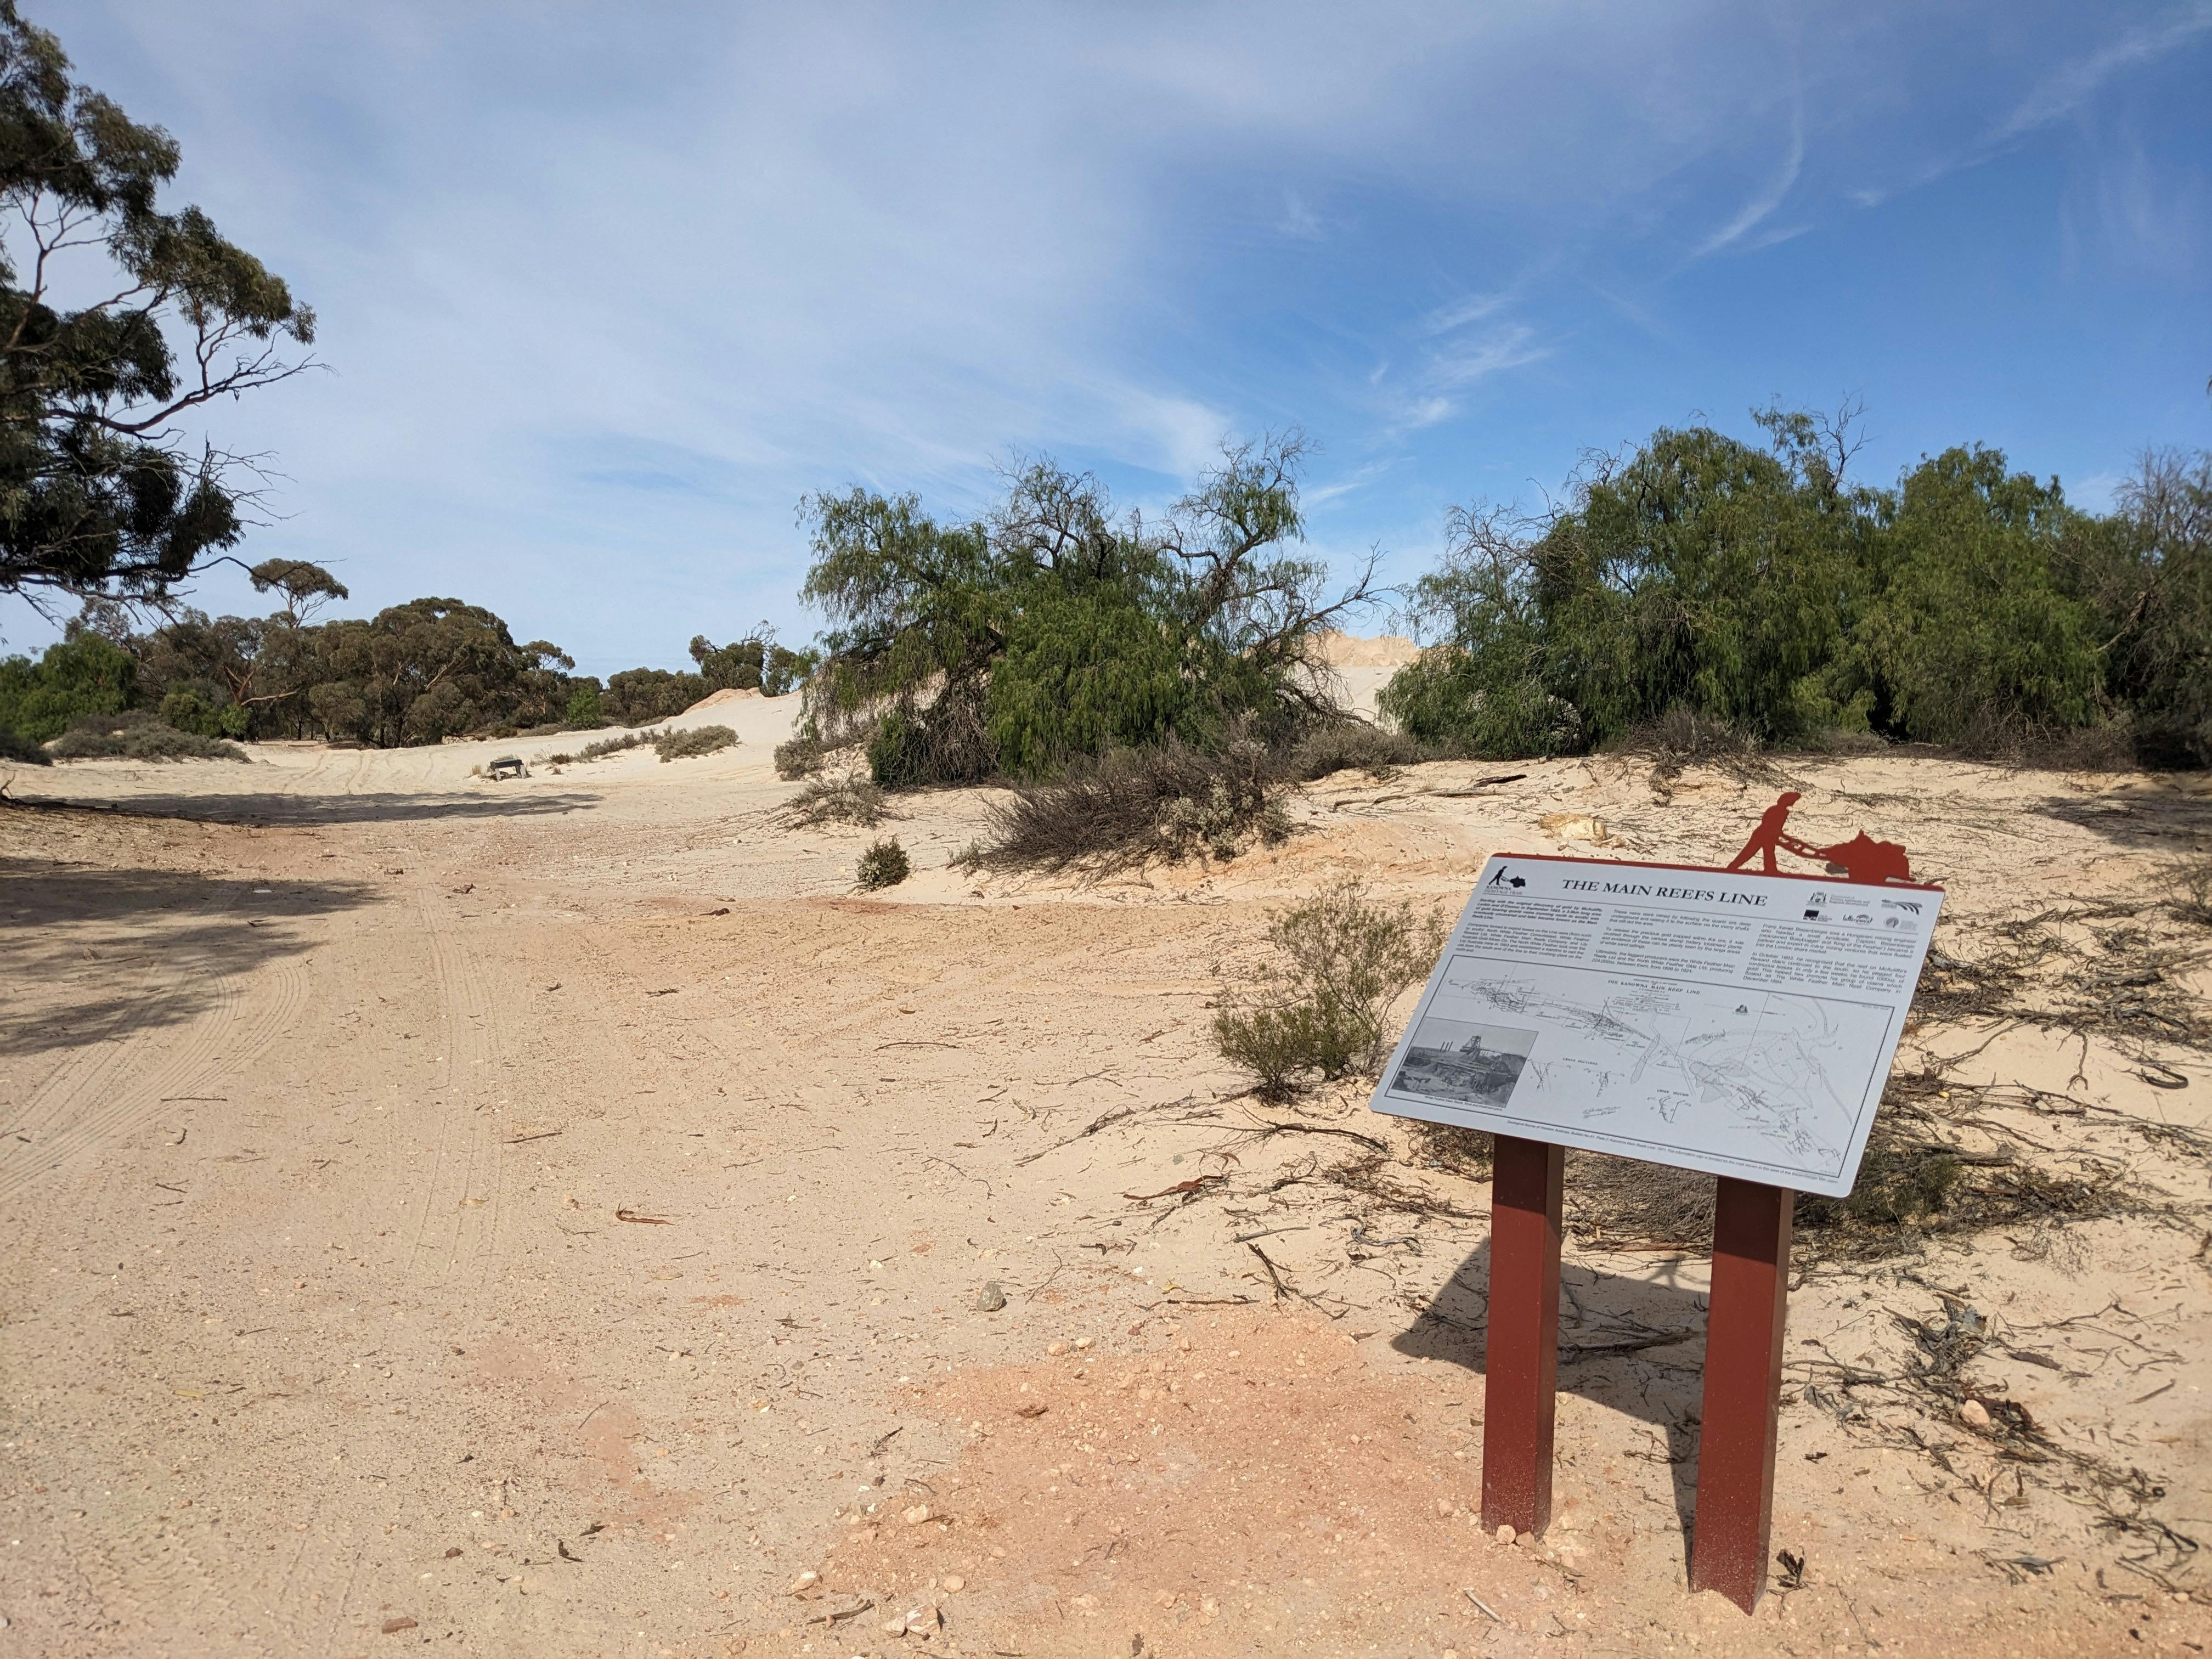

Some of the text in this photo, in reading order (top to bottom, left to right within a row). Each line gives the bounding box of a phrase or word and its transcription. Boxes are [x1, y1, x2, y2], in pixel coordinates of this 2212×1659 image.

[1562, 879, 1768, 906] THE MAIN REEFS LINE
